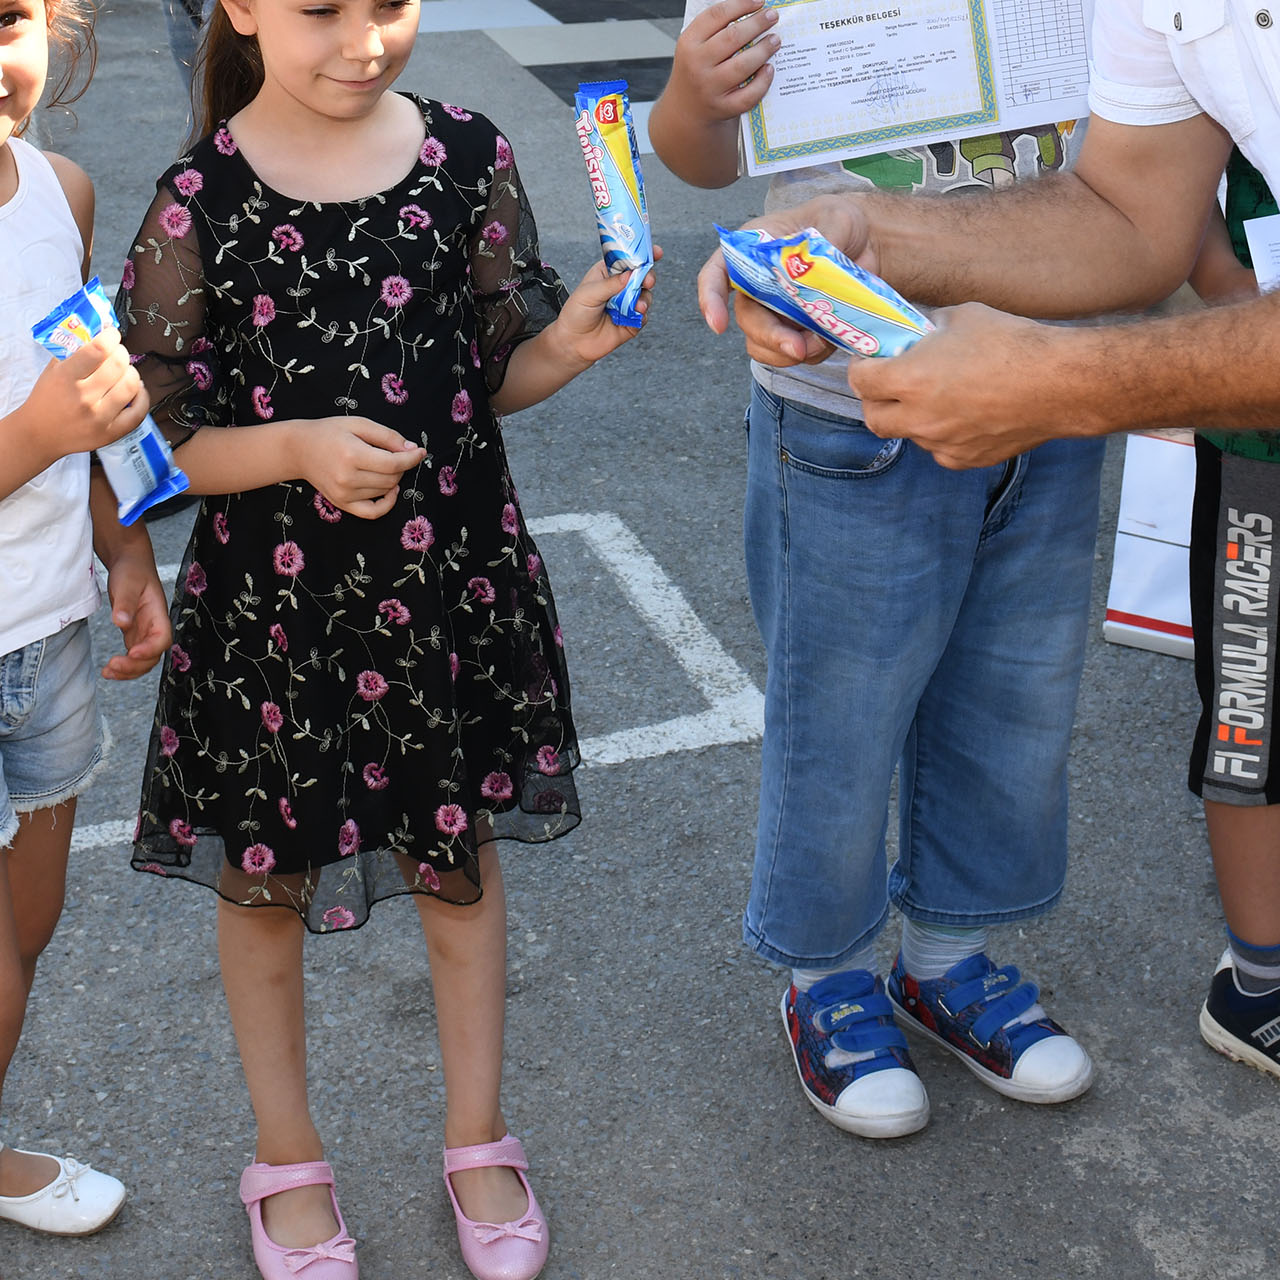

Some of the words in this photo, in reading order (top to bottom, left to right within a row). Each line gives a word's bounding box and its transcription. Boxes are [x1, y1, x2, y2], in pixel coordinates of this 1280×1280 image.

[818, 14, 865, 30] TEŞEKKÜR
[865, 7, 902, 23] BELGESİ
[1222, 507, 1273, 617] RACERS
[1218, 622, 1269, 746] FORMULA
